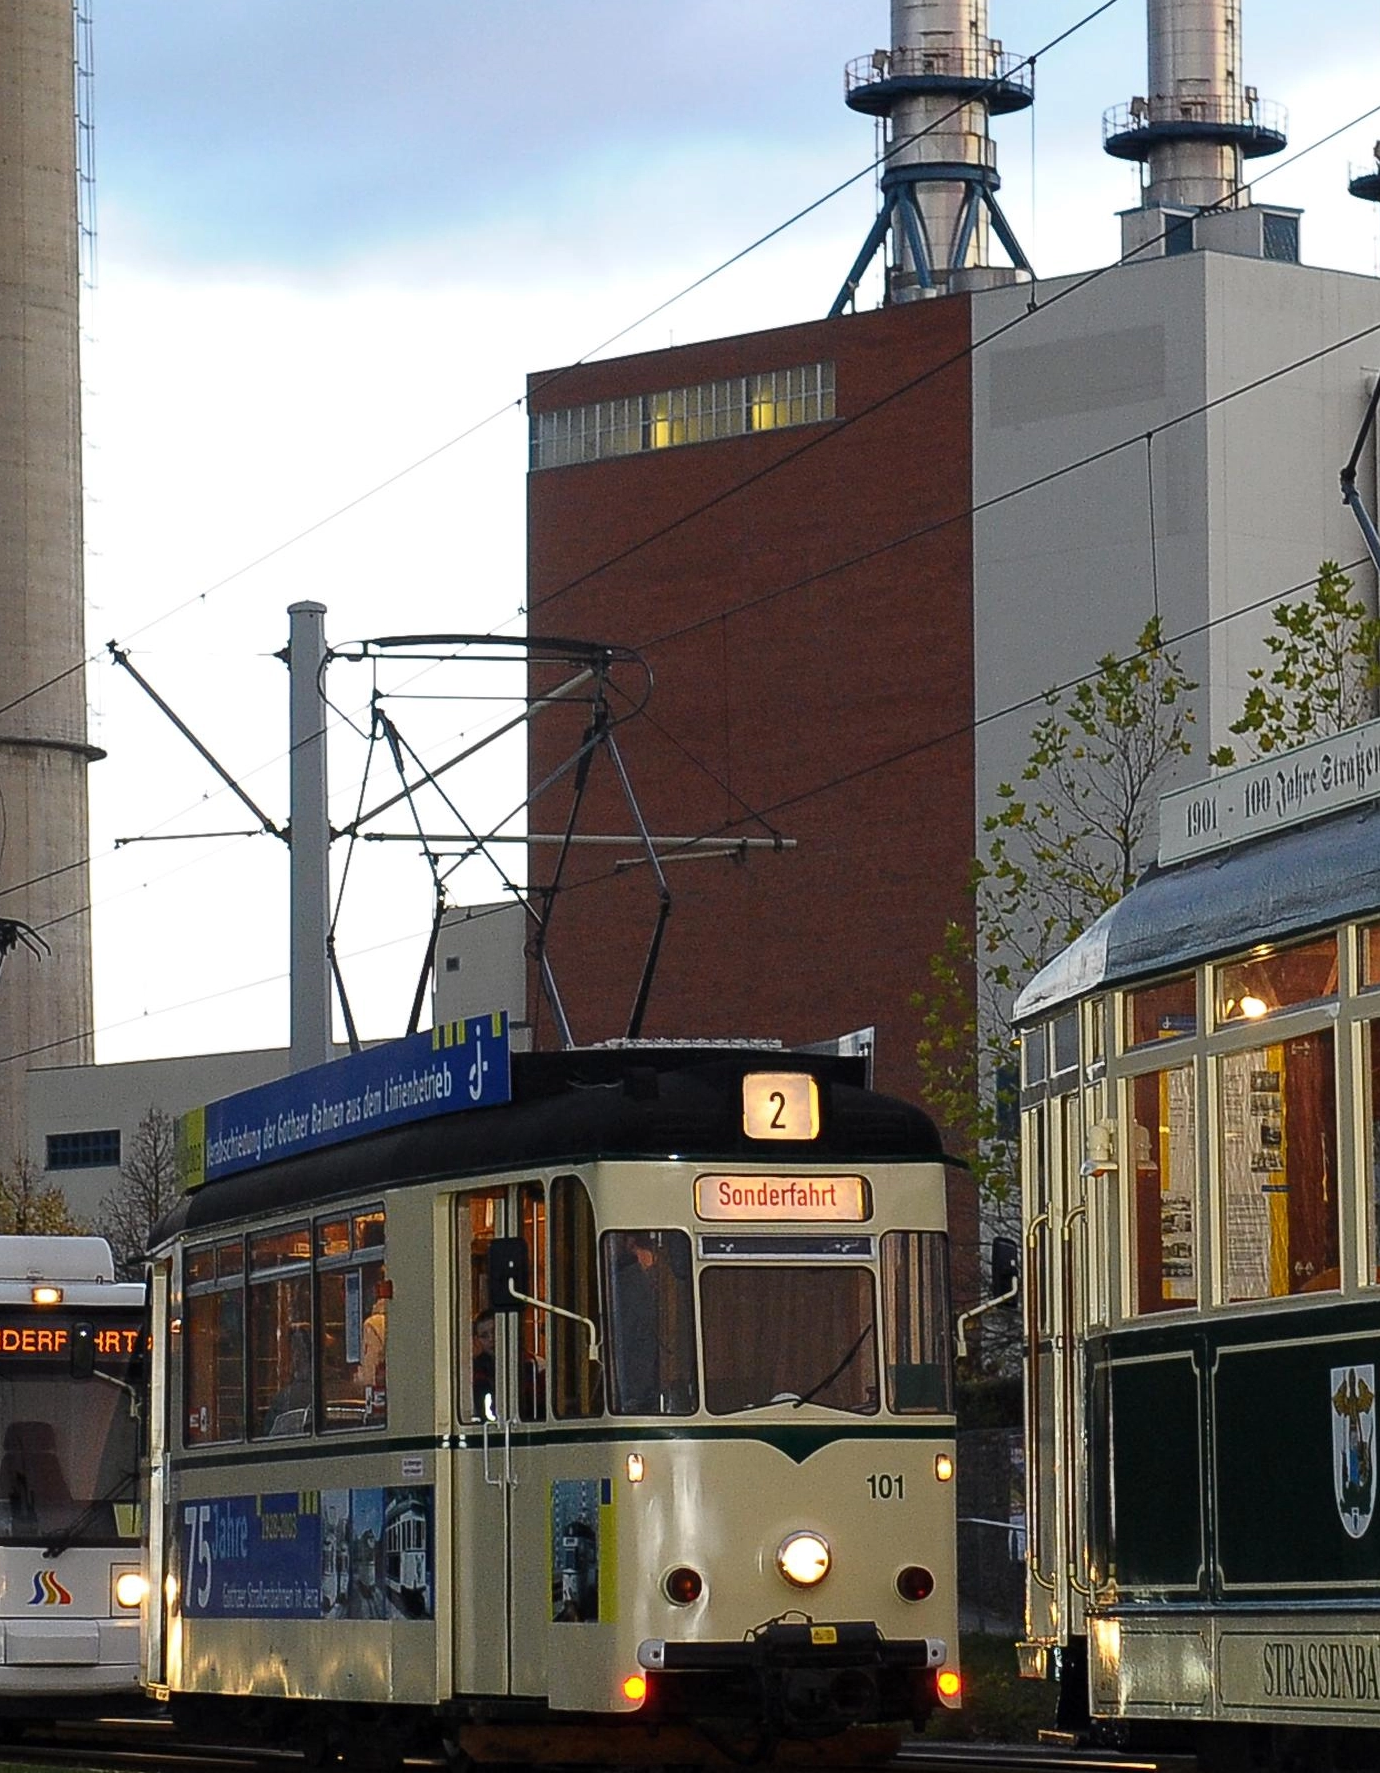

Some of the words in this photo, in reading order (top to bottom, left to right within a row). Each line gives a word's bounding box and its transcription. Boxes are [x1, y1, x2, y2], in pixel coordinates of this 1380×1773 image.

[1187, 796, 1217, 838] 1901
[1244, 776, 1271, 818] 100
[1275, 763, 1318, 818] Jahre
[262, 1116, 278, 1150] der
[277, 1108, 310, 1146] Gothaer
[311, 1098, 345, 1135] Bahnen
[345, 1095, 362, 1125] aus
[362, 1084, 382, 1120] dem
[384, 1061, 453, 1113] Linienbetrieb
[769, 1091, 787, 1129] 2
[718, 1181, 837, 1207] Sonderfahrt
[866, 1474, 904, 1500] 101
[184, 1505, 212, 1608] 75
[211, 1501, 248, 1560] Jahre
